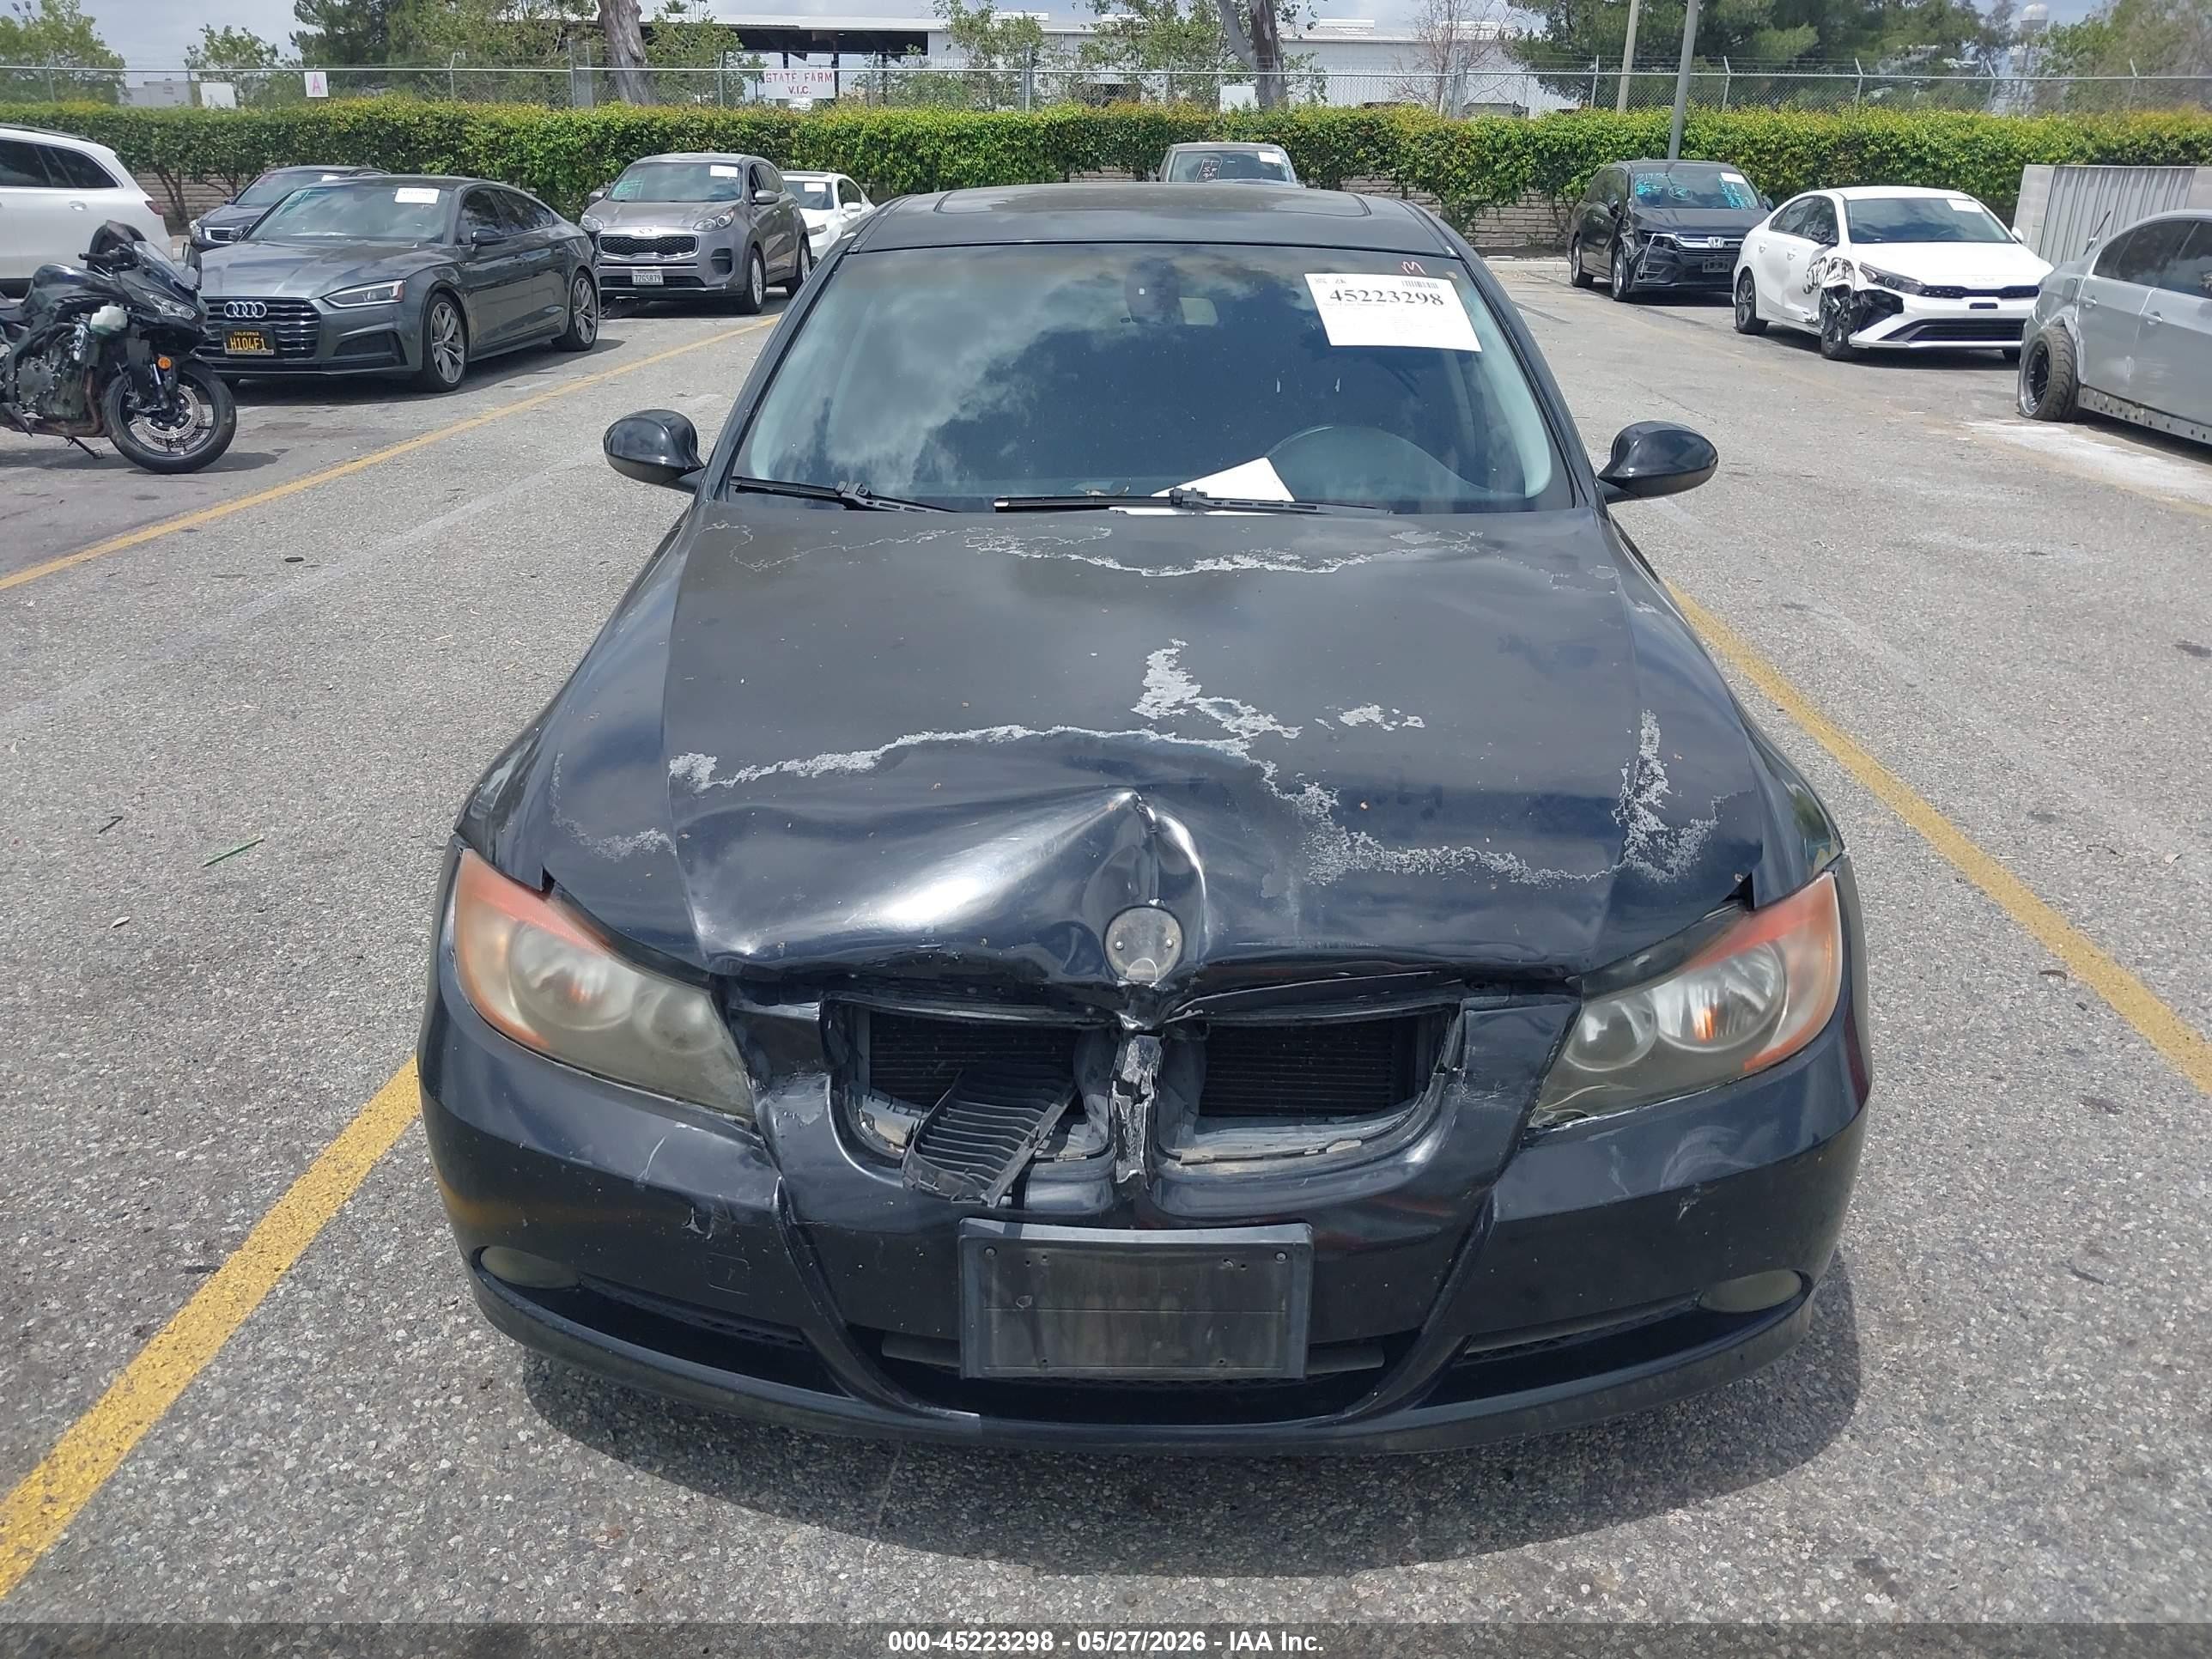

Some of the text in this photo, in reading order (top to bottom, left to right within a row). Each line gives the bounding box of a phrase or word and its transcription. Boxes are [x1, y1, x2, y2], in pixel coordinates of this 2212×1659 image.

[312, 73, 323, 94] A
[765, 71, 833, 83] STATE FARM
[787, 86, 811, 94] V.I.C.
[1329, 289, 1444, 306] 45223298
[229, 336, 267, 350] H104F1
